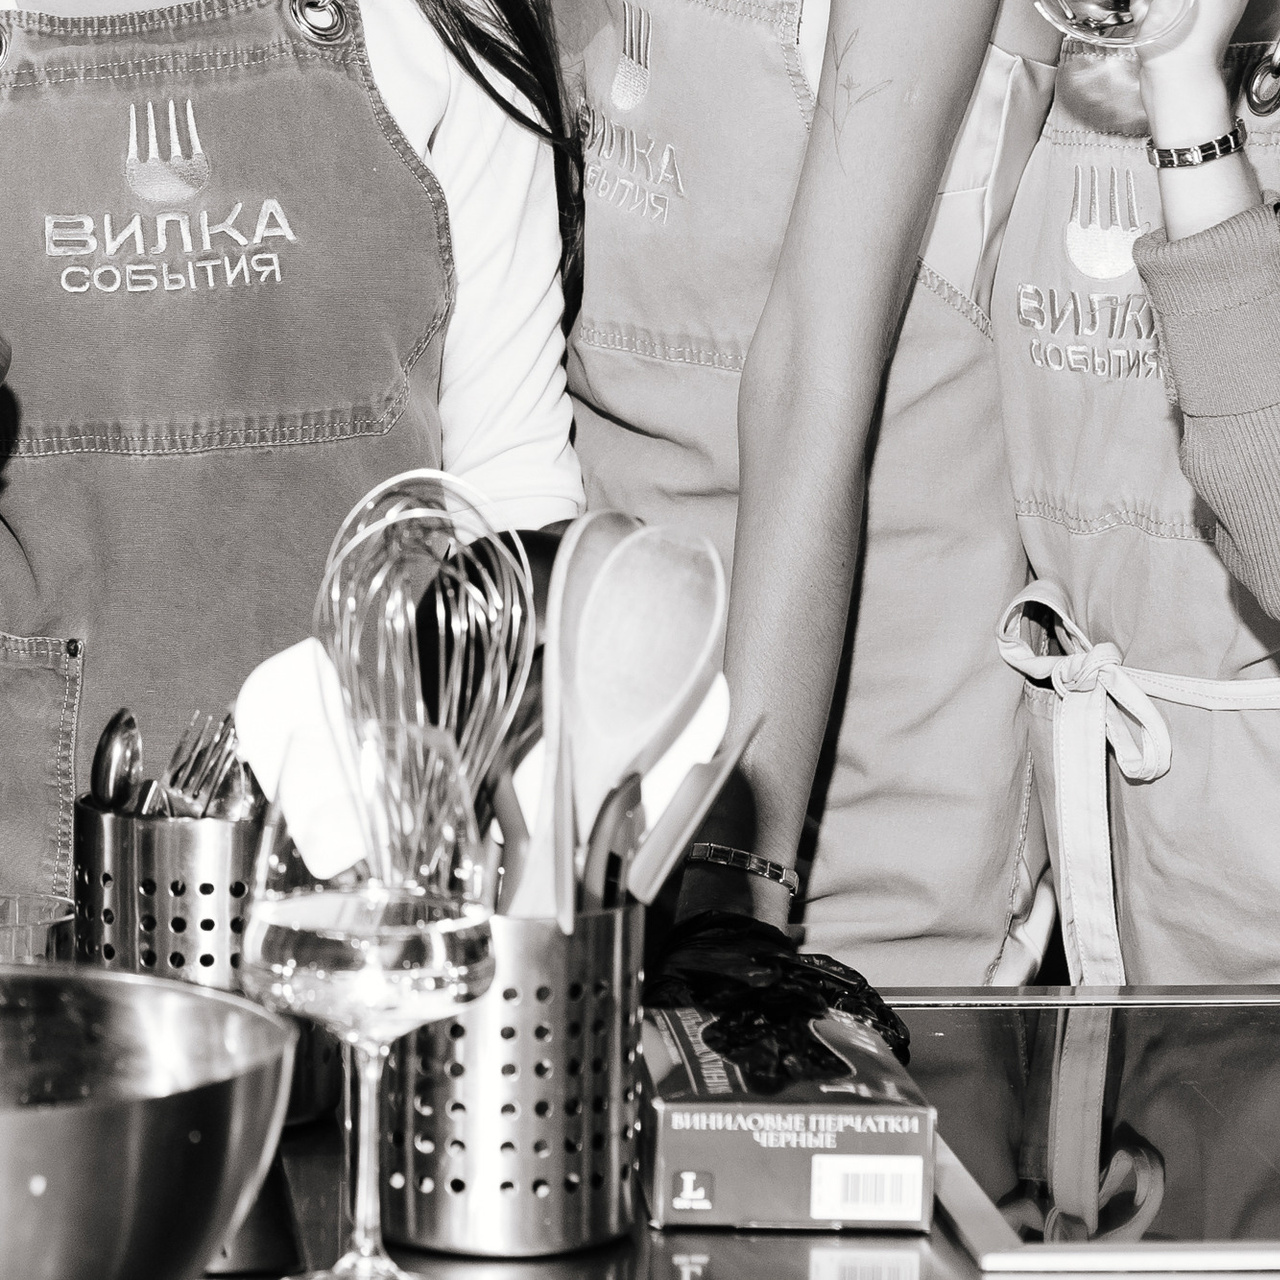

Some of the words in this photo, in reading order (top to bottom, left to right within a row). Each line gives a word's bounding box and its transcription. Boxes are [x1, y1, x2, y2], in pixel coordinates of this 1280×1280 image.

[585, 162, 669, 224] БЫТИЯ
[44, 198, 297, 256] ВИЛКА
[60, 253, 281, 292] СОБЫТИЯ
[1017, 283, 1157, 340] ВИЛК
[1030, 338, 1163, 379] СОБЫТИЯ
[671, 1111, 805, 1131] ВИНИЛОВЫЕ
[808, 1113, 919, 1133] ПЕРЧАТКИ
[752, 1130, 837, 1148] ЧЕРНЫЕ
[680, 1171, 706, 1200] L
